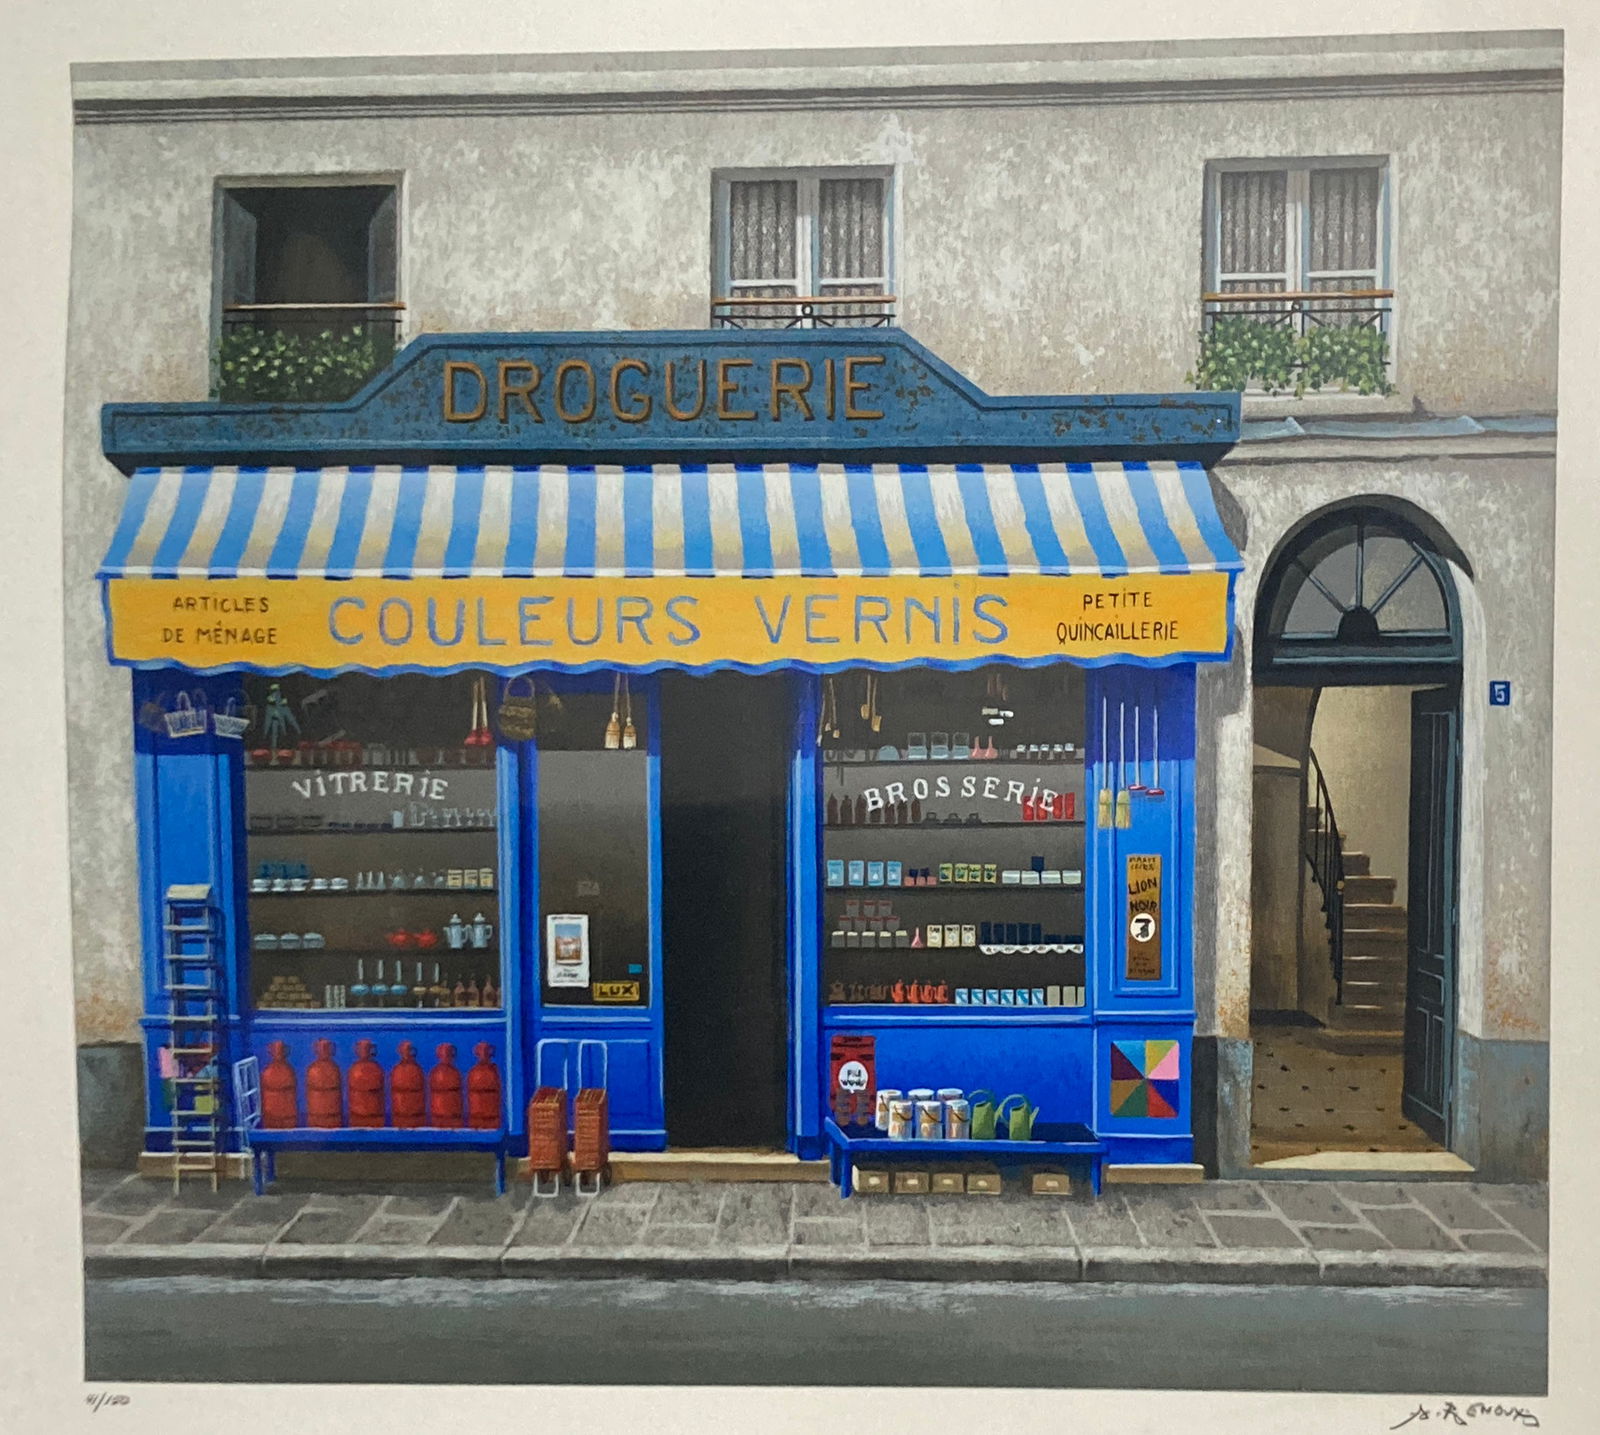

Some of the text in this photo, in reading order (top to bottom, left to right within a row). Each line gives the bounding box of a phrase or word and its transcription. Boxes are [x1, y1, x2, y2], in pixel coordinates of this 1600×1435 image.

[443, 354, 886, 424] DROGUERIE
[173, 596, 269, 613] ARTICLES
[328, 595, 701, 646] COULEURS
[162, 620, 278, 645] DE MÉNAGE
[1493, 683, 1506, 703] 5
[1128, 877, 1157, 895] LION
[1129, 899, 1158, 914] NOIR
[599, 983, 634, 996] LUX
